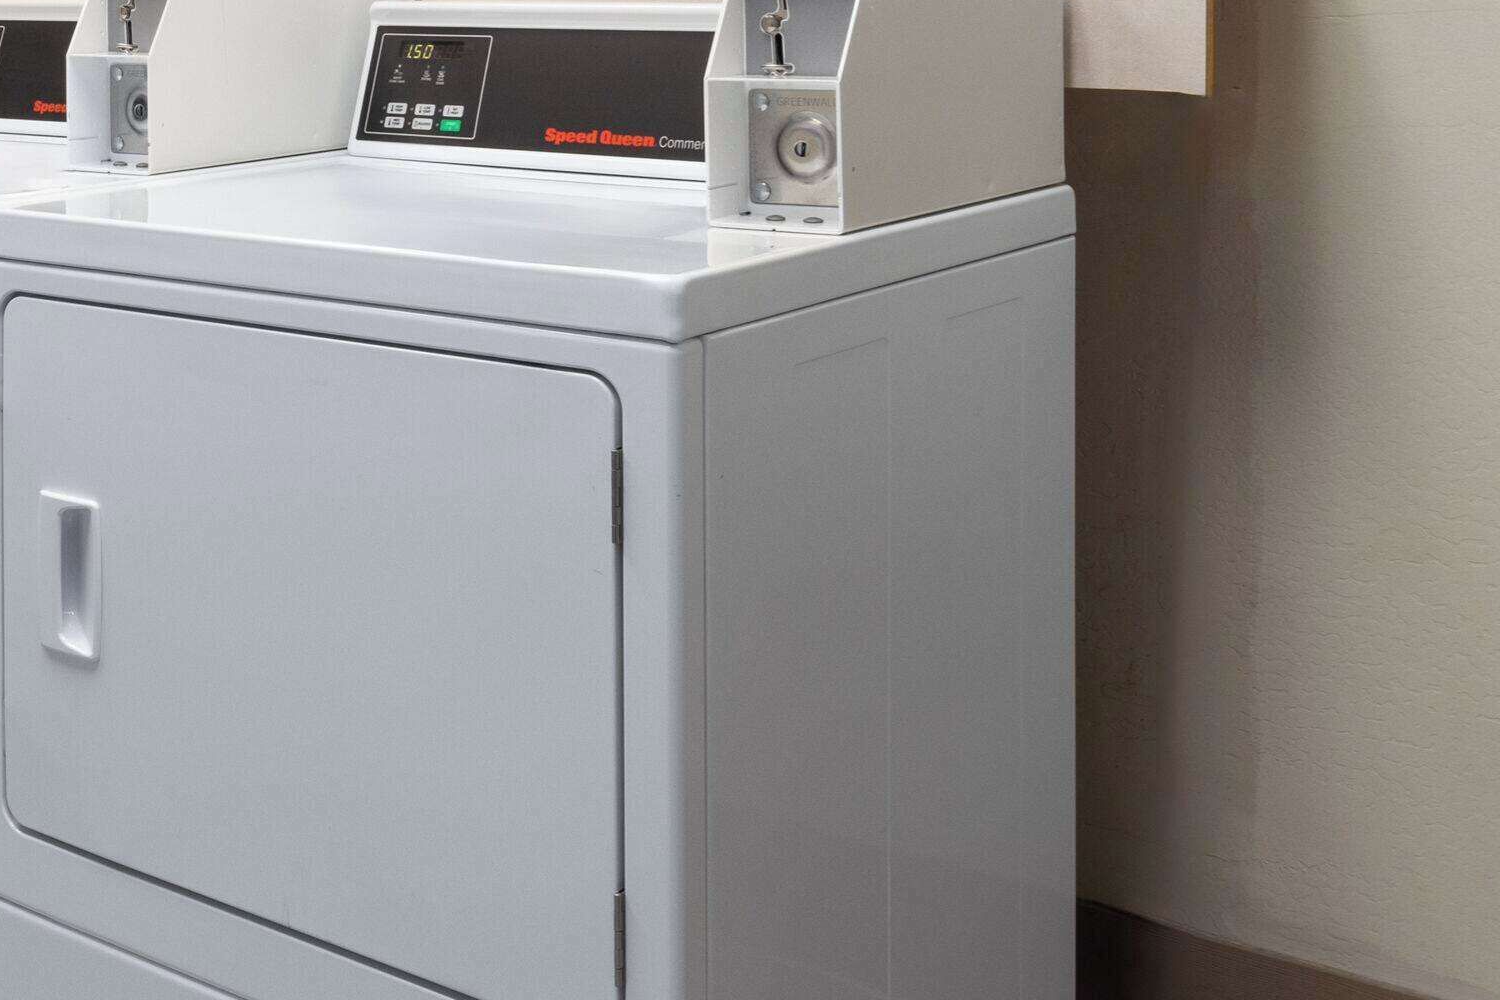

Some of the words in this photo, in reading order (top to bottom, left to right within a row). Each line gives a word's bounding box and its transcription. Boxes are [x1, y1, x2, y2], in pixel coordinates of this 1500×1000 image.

[545, 127, 598, 145] Speed
[600, 129, 656, 146] Queen
[658, 135, 706, 150] Commer
